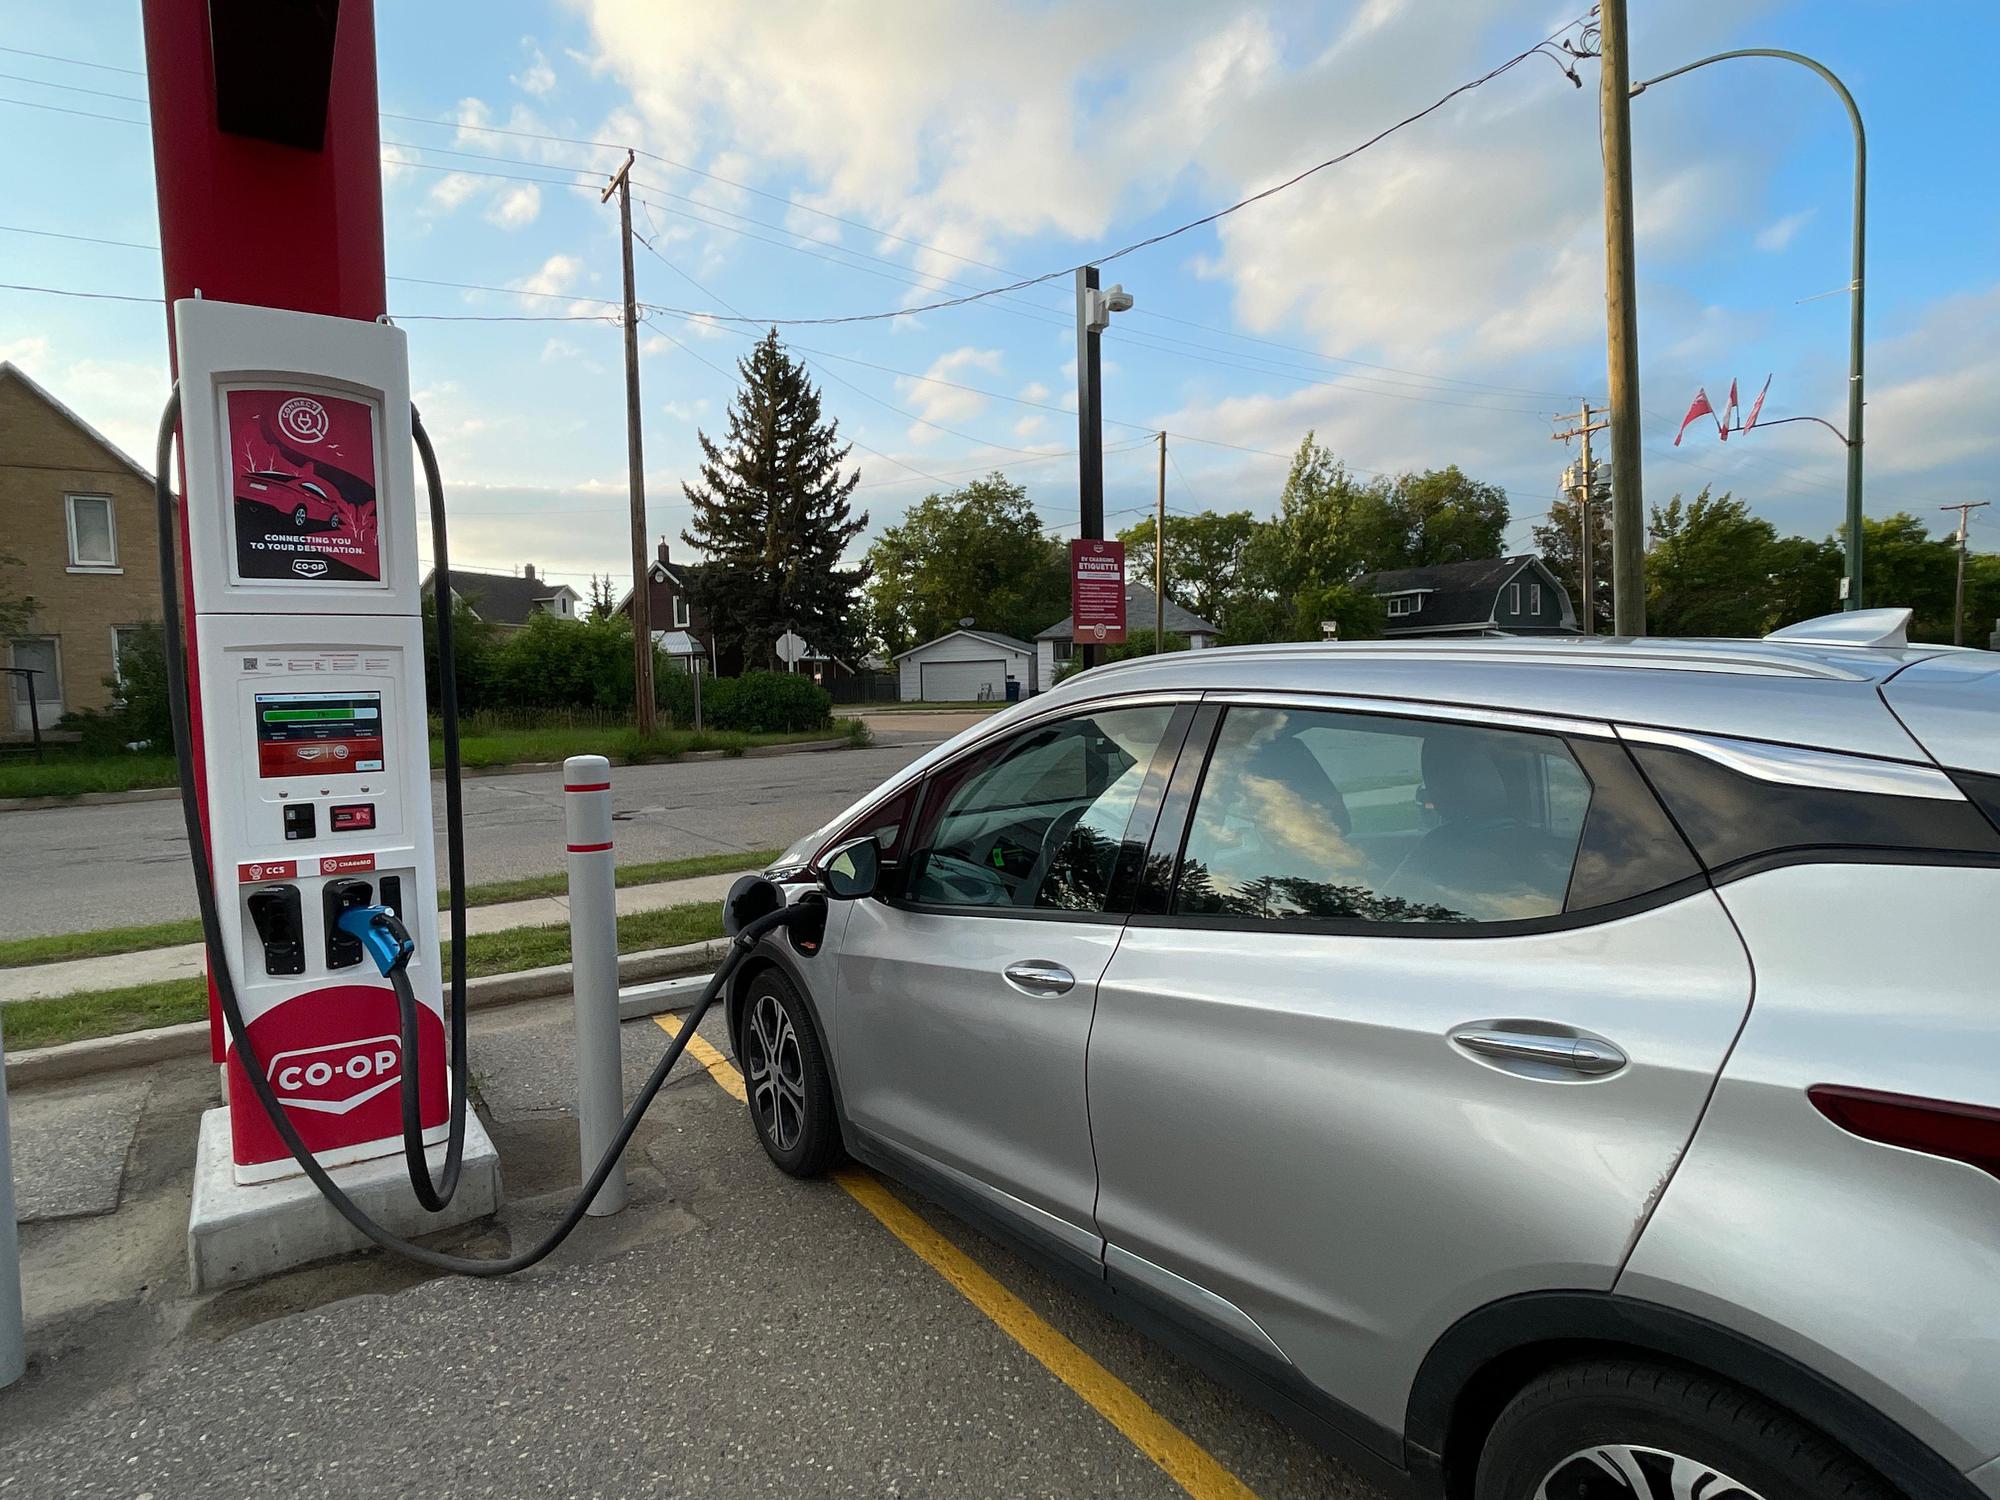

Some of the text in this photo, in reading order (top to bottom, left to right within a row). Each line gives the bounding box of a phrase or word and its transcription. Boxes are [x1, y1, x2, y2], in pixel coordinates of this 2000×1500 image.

[282, 400, 318, 418] CONNECT
[264, 533, 352, 545] CONNECTING YOU
[250, 542, 366, 555] TO YOUR DESTINATION.
[295, 562, 325, 571] CO-OP
[1079, 562, 1119, 571] ETIQUETTE
[266, 866, 285, 875] CCS
[278, 1050, 397, 1091] CO-OP
